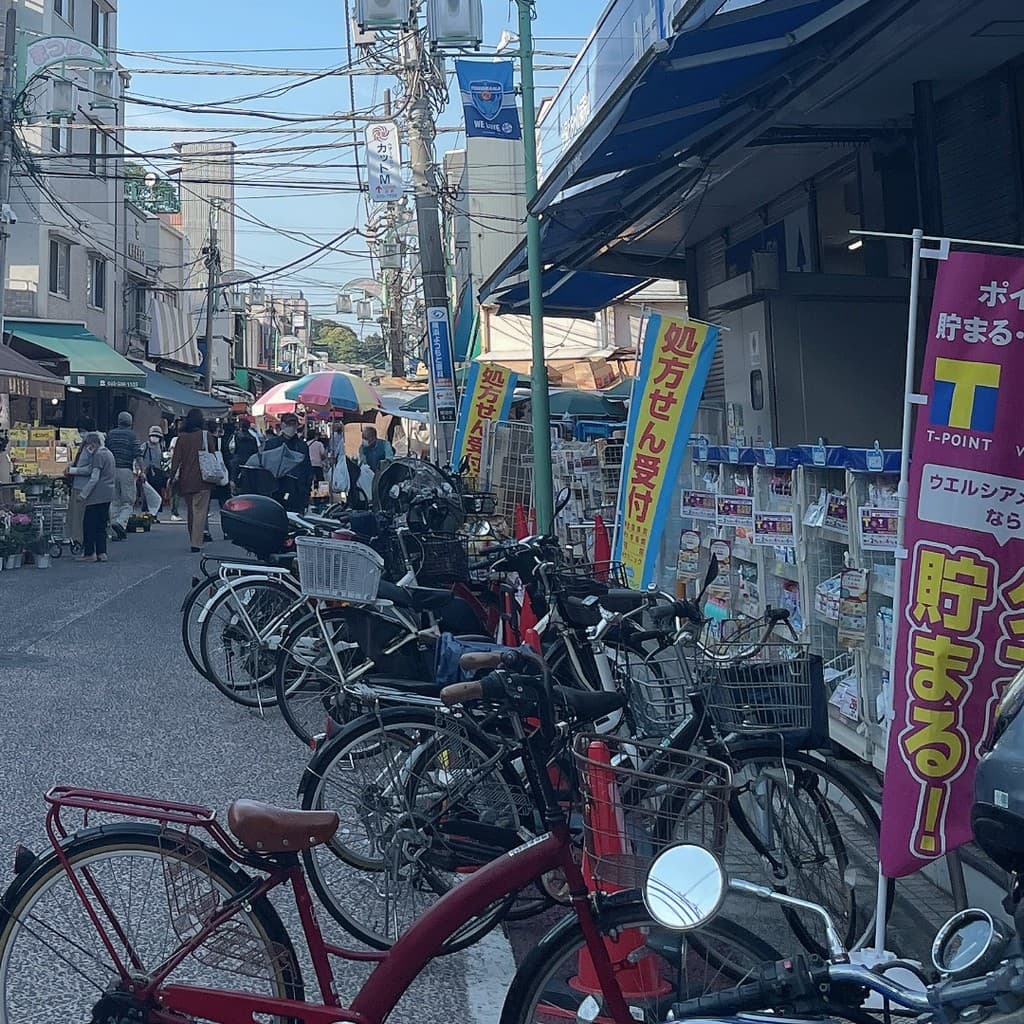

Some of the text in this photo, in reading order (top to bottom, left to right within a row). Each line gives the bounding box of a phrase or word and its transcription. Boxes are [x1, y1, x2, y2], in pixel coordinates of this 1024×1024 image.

[473, 119, 485, 129] WE
[377, 143, 391, 185] カットM
[628, 322, 699, 524] 処方せん受付
[927, 430, 993, 451] T-POINT
[986, 508, 1022, 529] なら
[905, 549, 989, 852] 貯まる!
